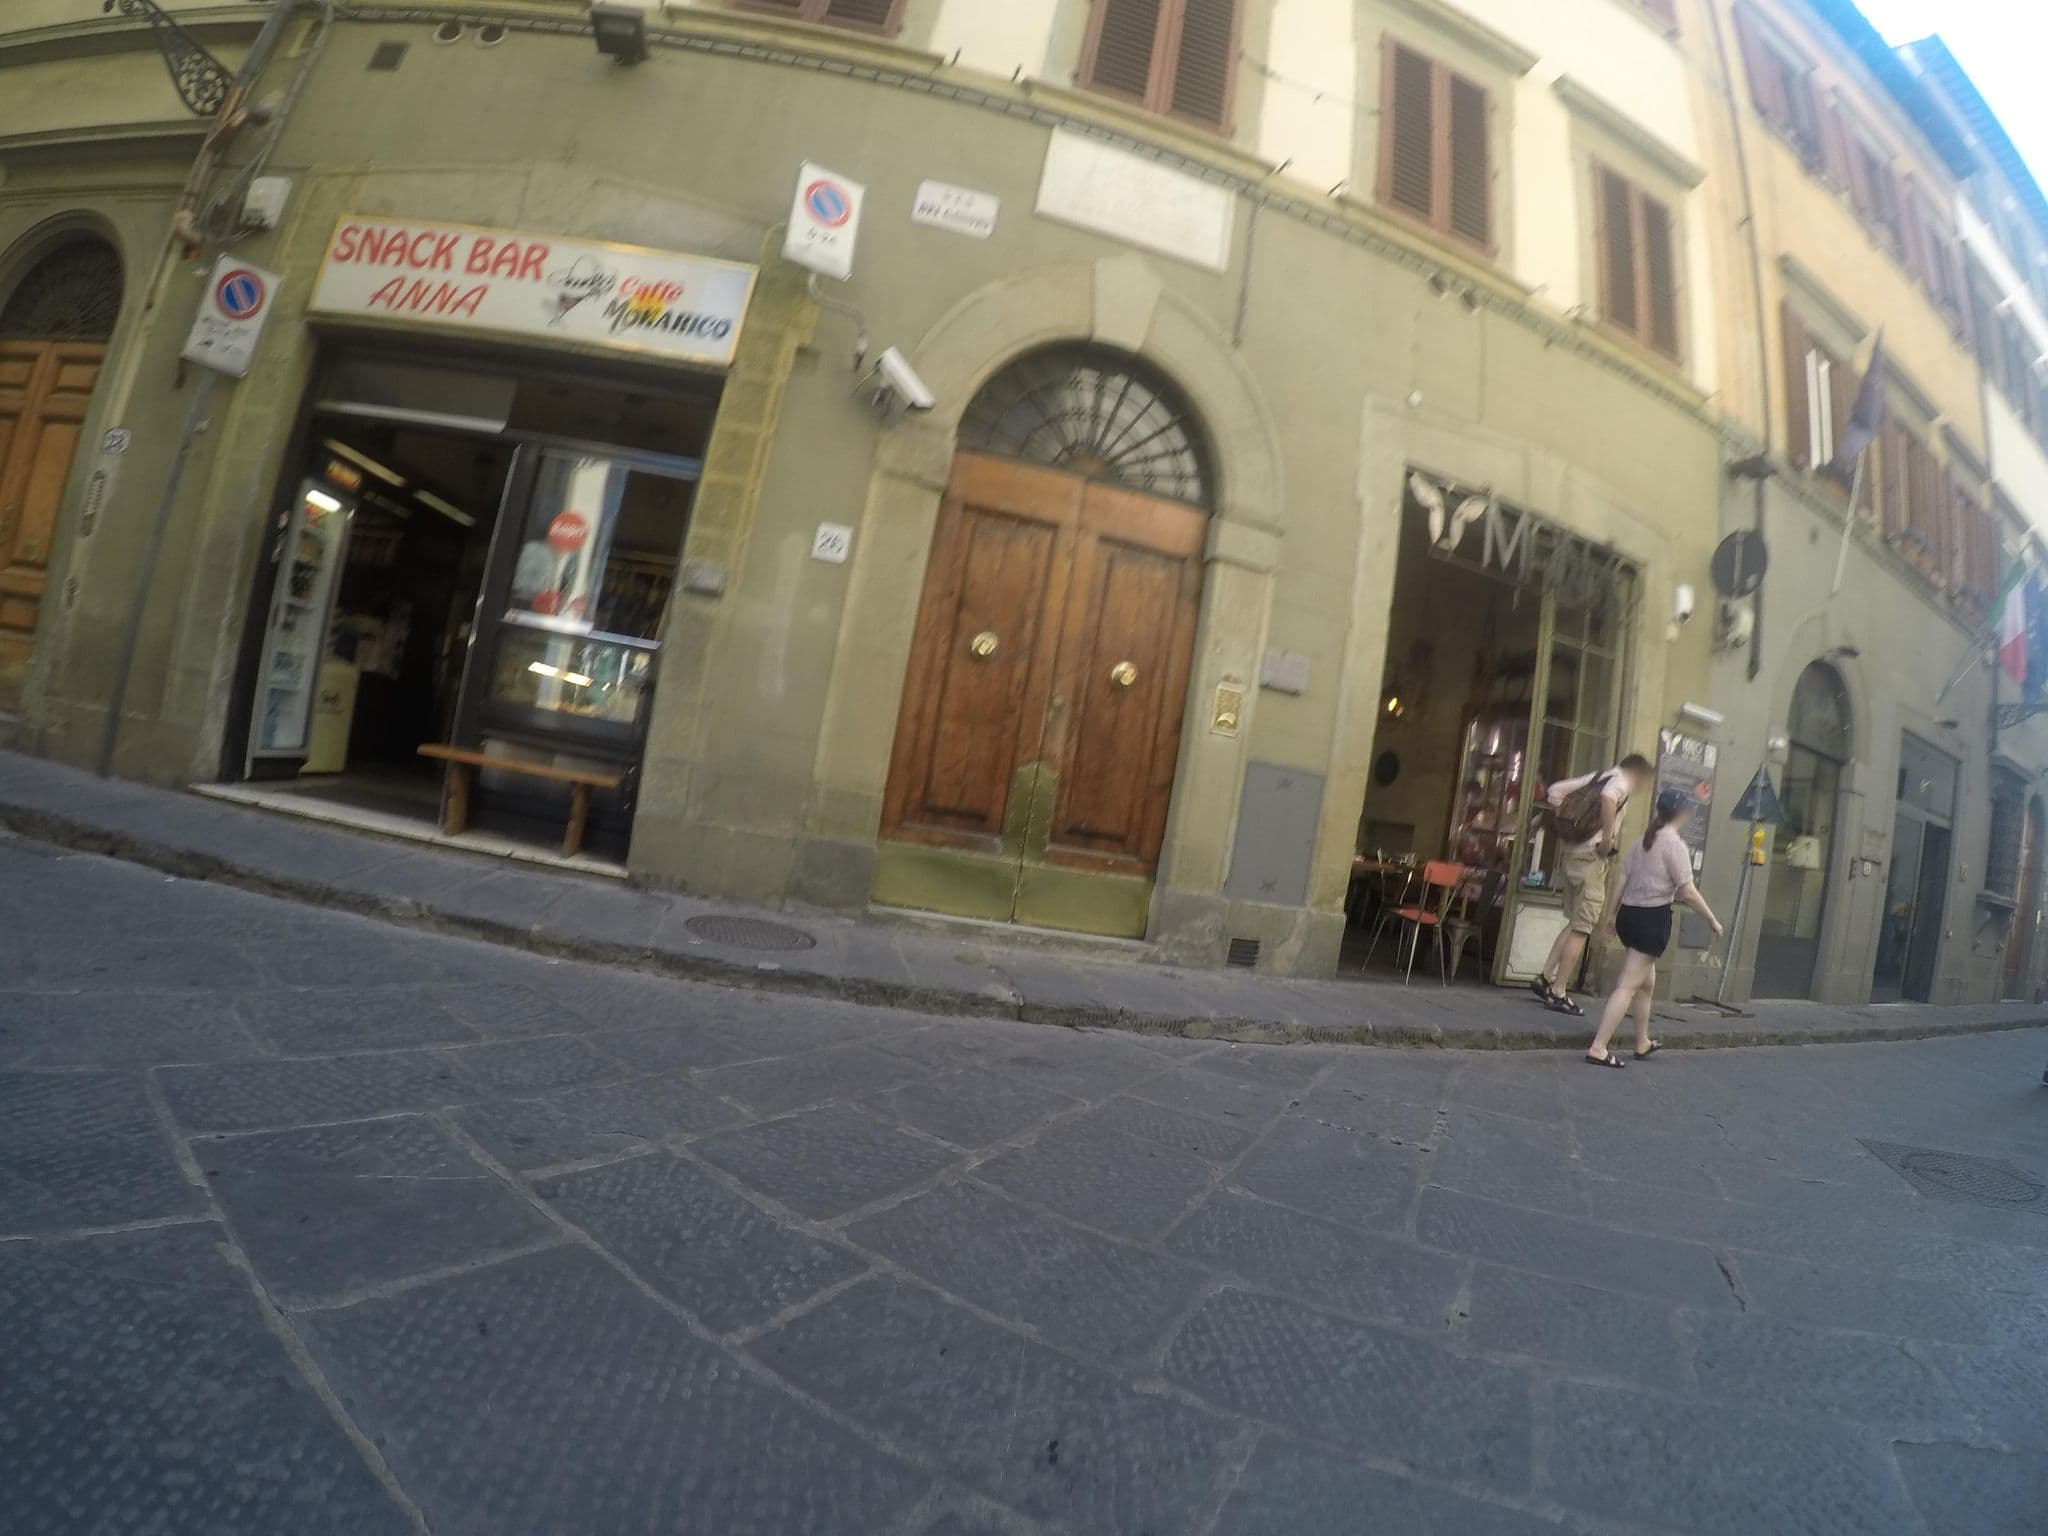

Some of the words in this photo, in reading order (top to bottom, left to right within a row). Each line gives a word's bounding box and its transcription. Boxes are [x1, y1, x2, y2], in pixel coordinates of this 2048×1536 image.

[332, 224, 461, 272] SNACK
[464, 236, 549, 282] BAR
[367, 276, 490, 318] ANNA
